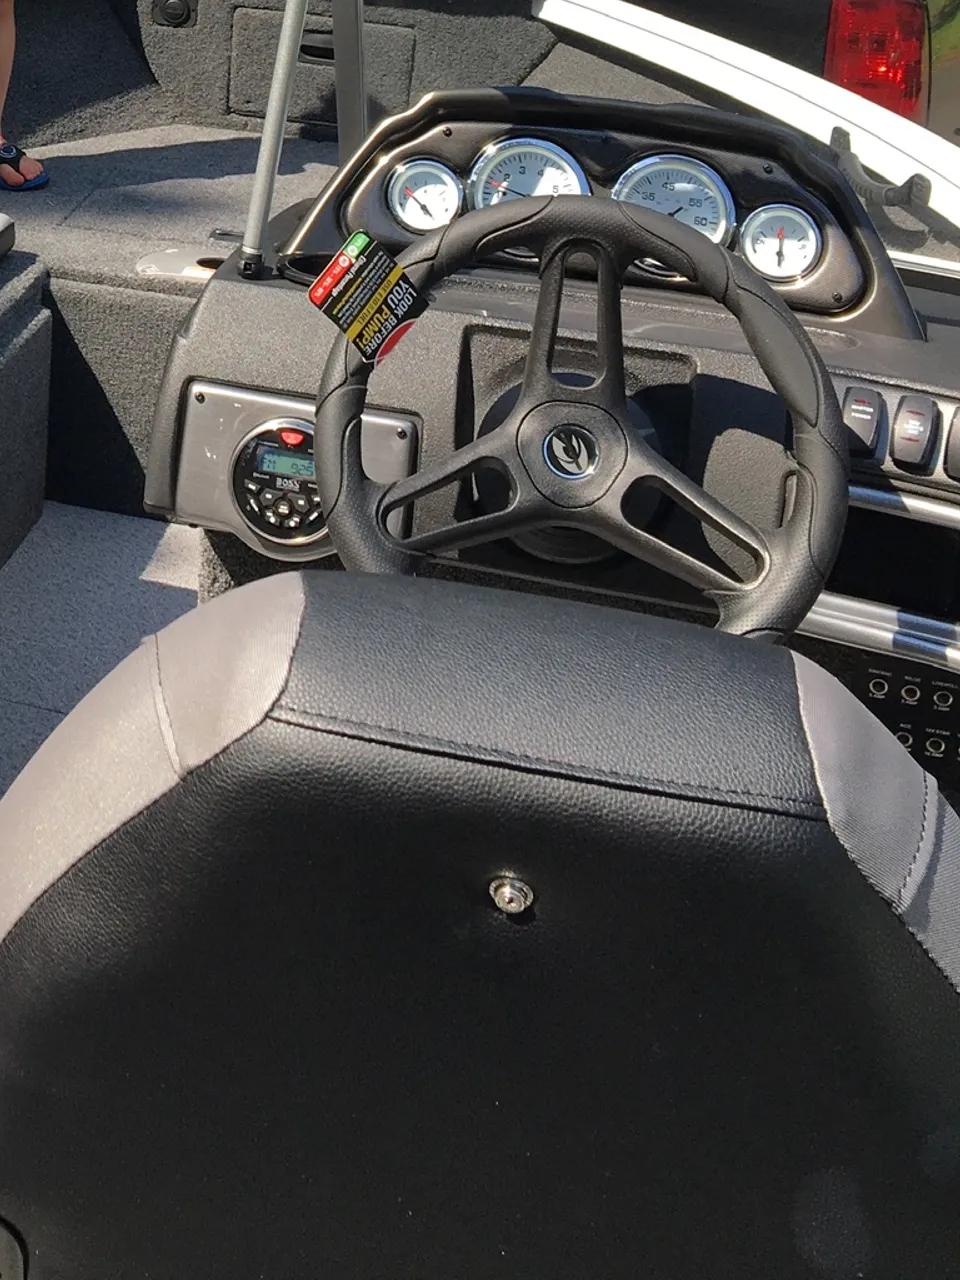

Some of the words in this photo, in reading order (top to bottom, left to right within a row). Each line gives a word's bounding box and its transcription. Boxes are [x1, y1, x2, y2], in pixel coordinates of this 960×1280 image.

[519, 166, 526, 175] 3
[552, 185, 559, 194] 5
[662, 182, 675, 191] 45
[642, 192, 655, 201] 35
[689, 198, 702, 208] 55
[694, 216, 707, 226] 60
[387, 280, 409, 308] YOU
[393, 288, 416, 317] LOOK
[356, 304, 390, 348] PUMP!
[363, 314, 396, 354] BEFORE
[276, 477, 300, 489] BOSS
